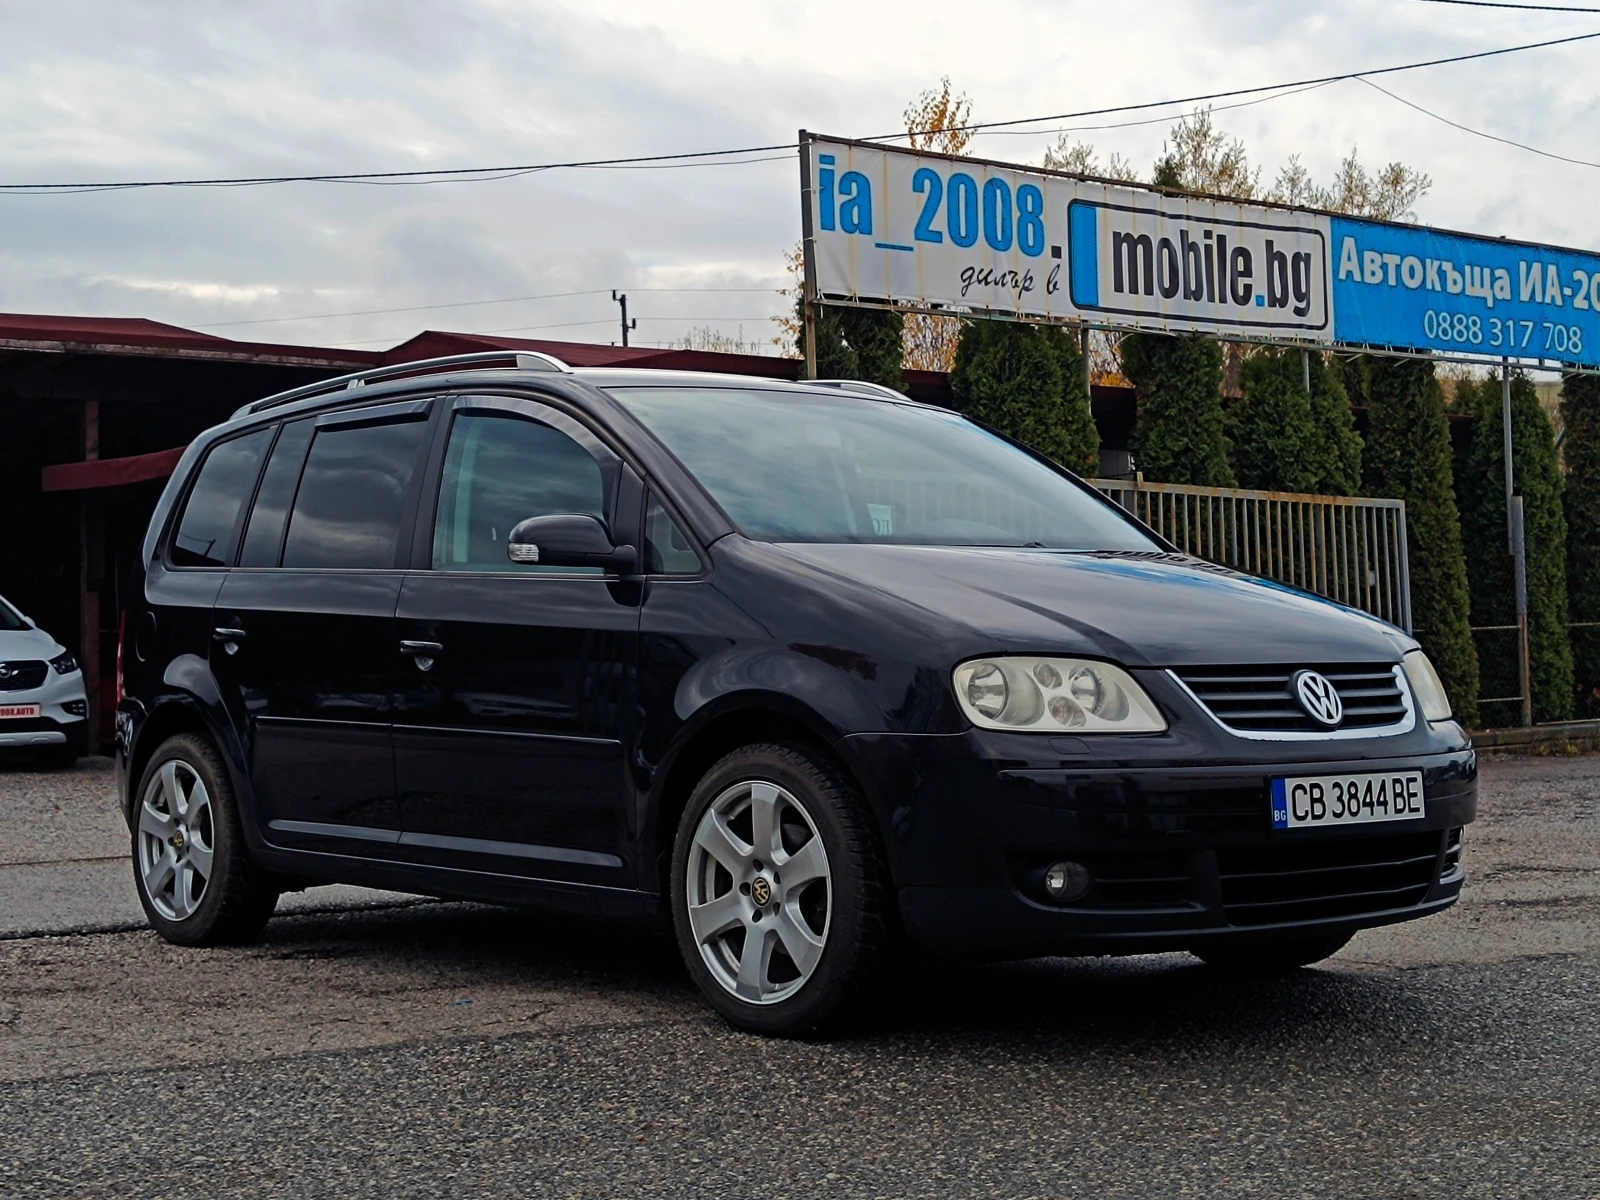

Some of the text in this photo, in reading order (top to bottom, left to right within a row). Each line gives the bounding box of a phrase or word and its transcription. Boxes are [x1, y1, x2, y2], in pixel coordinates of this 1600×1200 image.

[960, 265, 1035, 300] дилър
[1112, 229, 1312, 318] mobile.bg
[1338, 236, 1512, 308] Автокъща
[1424, 309, 1582, 354] 0888 317 708
[1274, 810, 1287, 822] BG
